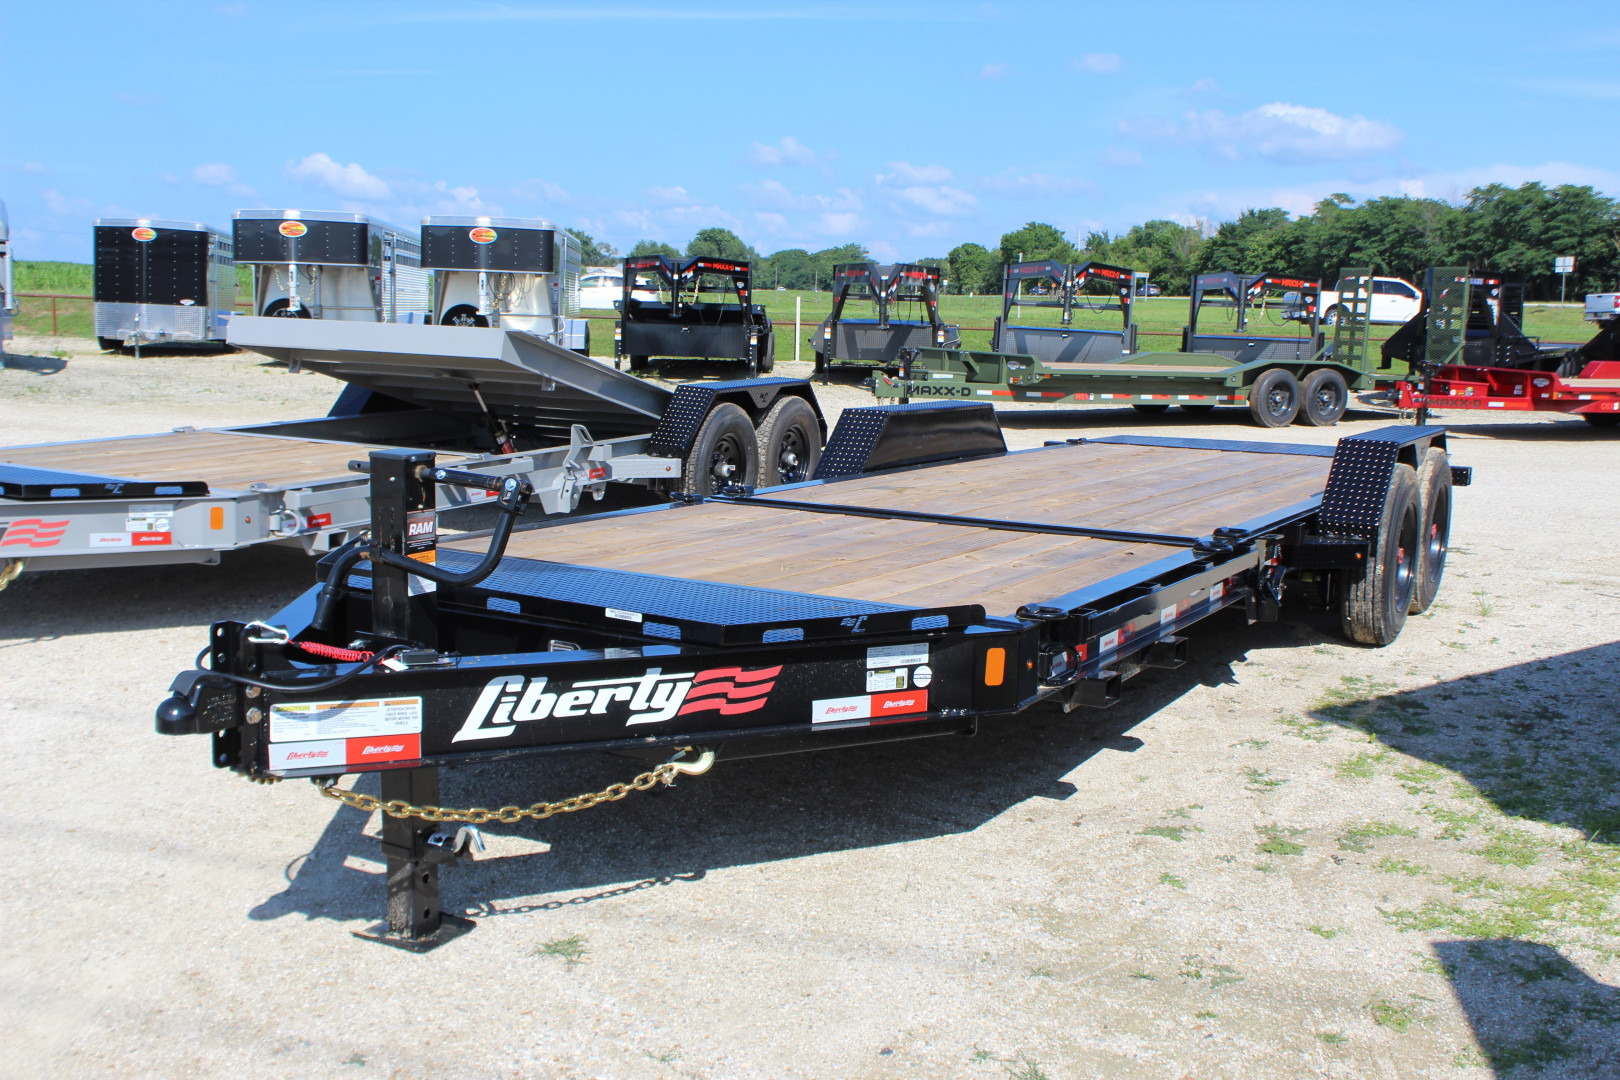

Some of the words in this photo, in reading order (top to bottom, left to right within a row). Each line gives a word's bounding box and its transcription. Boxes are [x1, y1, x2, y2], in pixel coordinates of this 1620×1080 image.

[907, 385, 972, 397] MAXX-D
[1428, 399, 1481, 408] MAXX-D
[408, 521, 434, 536] RAM
[451, 667, 696, 743] Liberty
[883, 700, 905, 709] Liberty
[825, 706, 848, 715] Liberty
[361, 745, 392, 755] Liberty
[286, 751, 317, 760] Liberty
